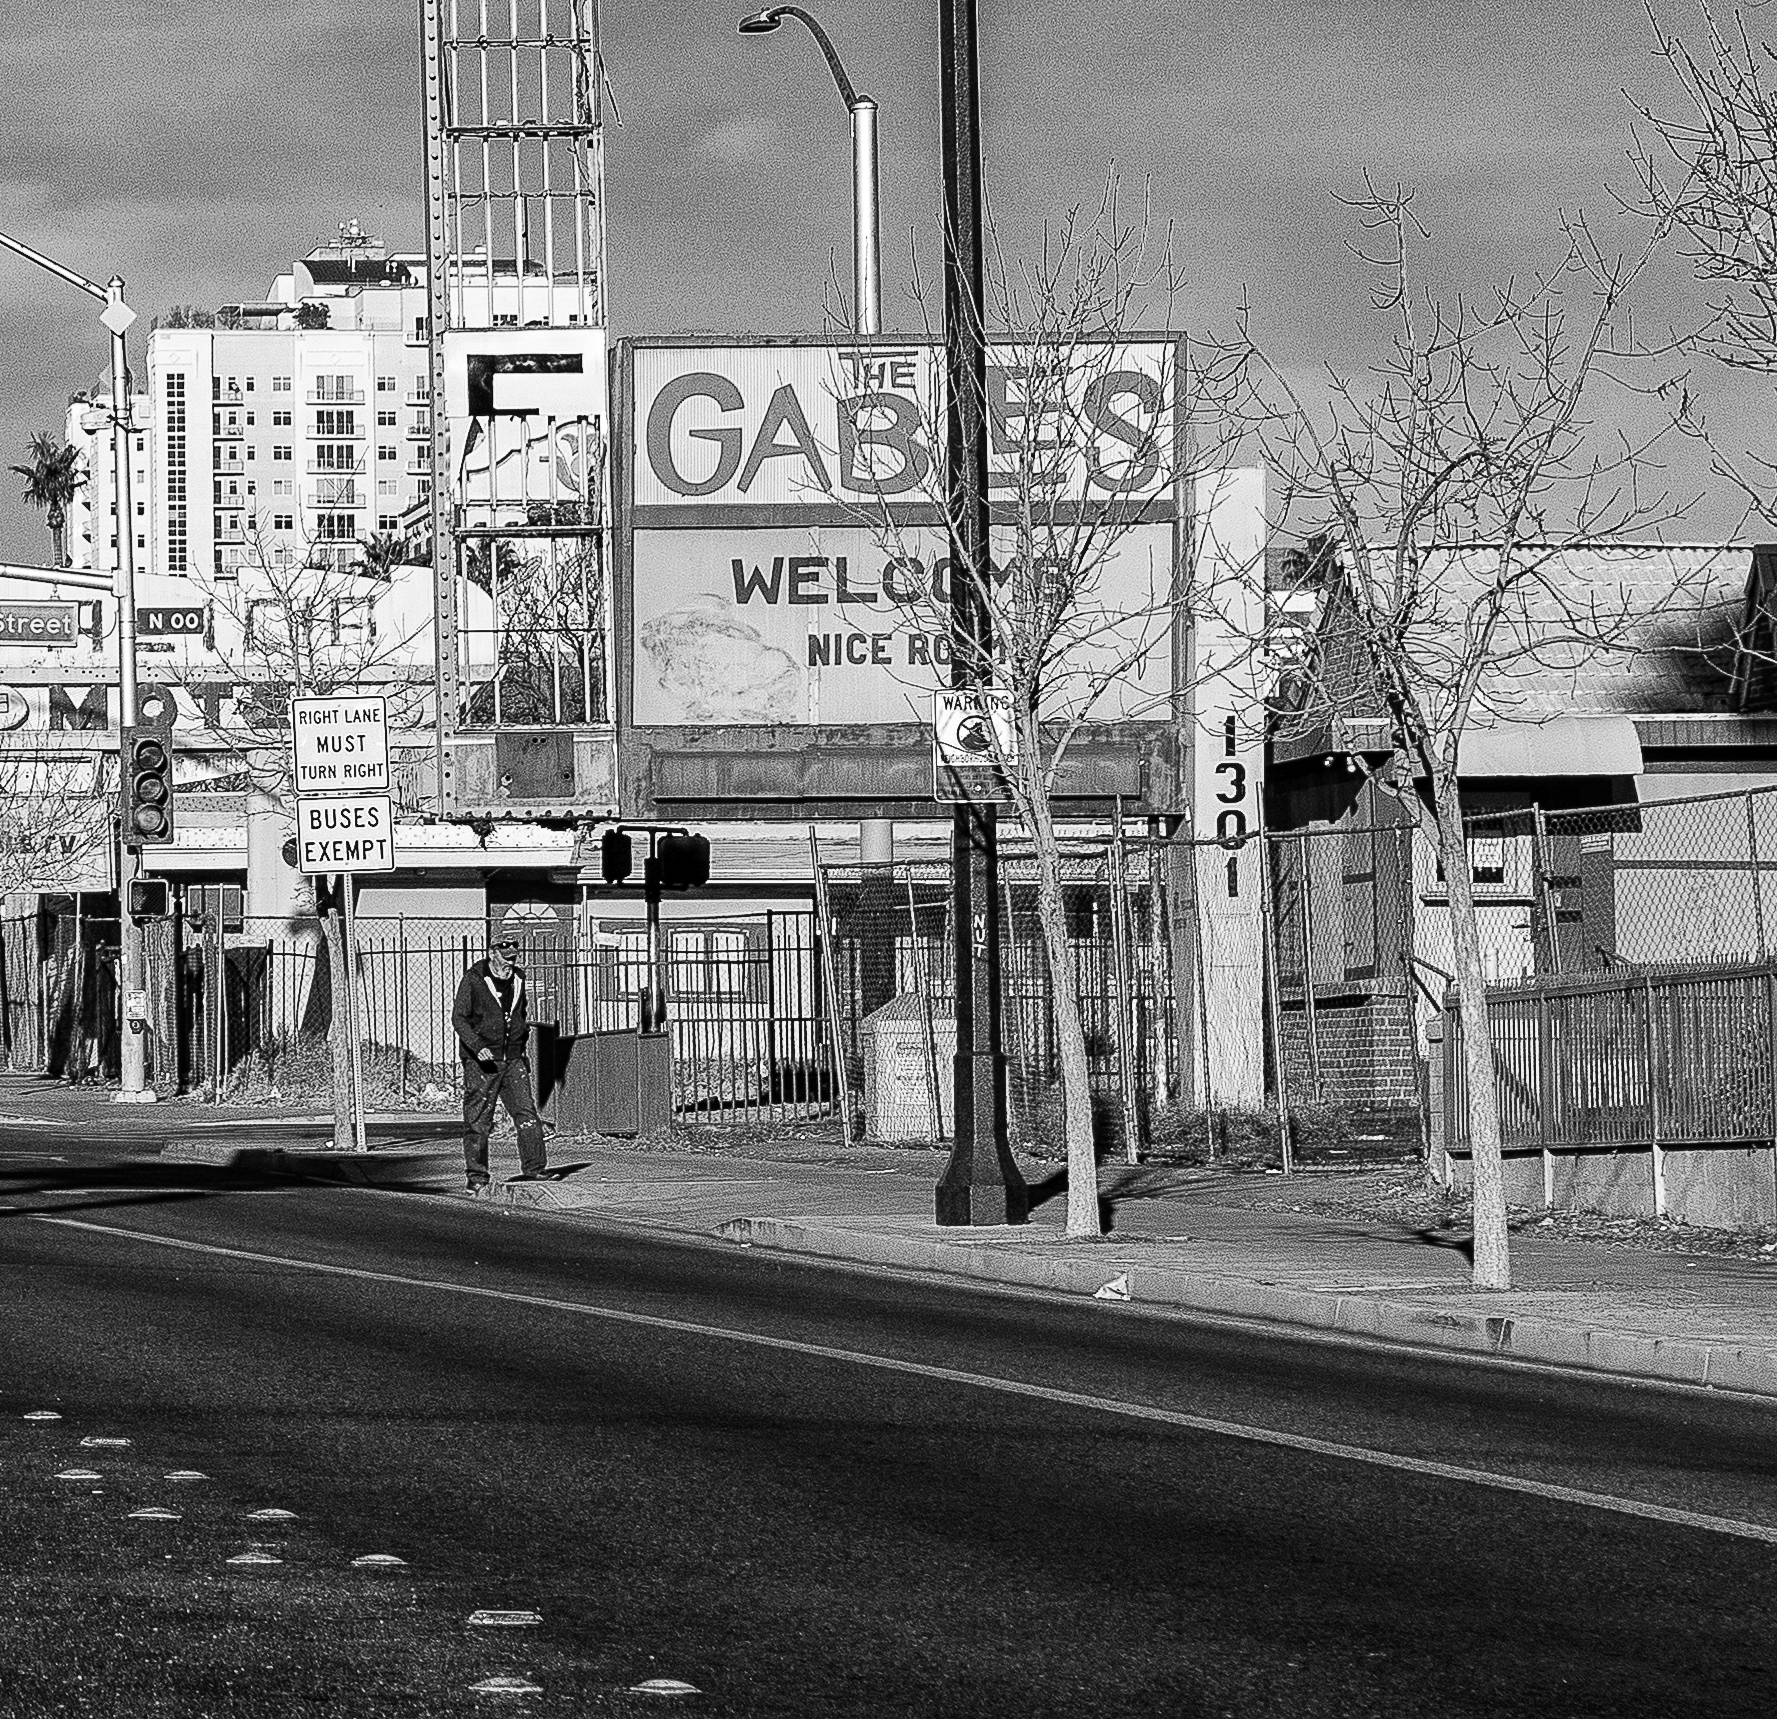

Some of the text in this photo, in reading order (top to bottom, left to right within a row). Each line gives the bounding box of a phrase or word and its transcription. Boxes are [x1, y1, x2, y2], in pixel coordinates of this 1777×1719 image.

[838, 351, 918, 389] THE
[646, 370, 1161, 497] GABES
[148, 612, 198, 629] N 00
[808, 633, 893, 667] NICE
[49, 683, 293, 729] MOTE
[943, 695, 1011, 711] WARNNG
[298, 708, 381, 725] RIGHT LANE
[316, 735, 366, 753] MUST
[300, 762, 384, 780] TURN RIGHT
[1215, 715, 1247, 898] 1301
[310, 807, 379, 829] BUSES
[305, 840, 387, 863] EXEMPT
